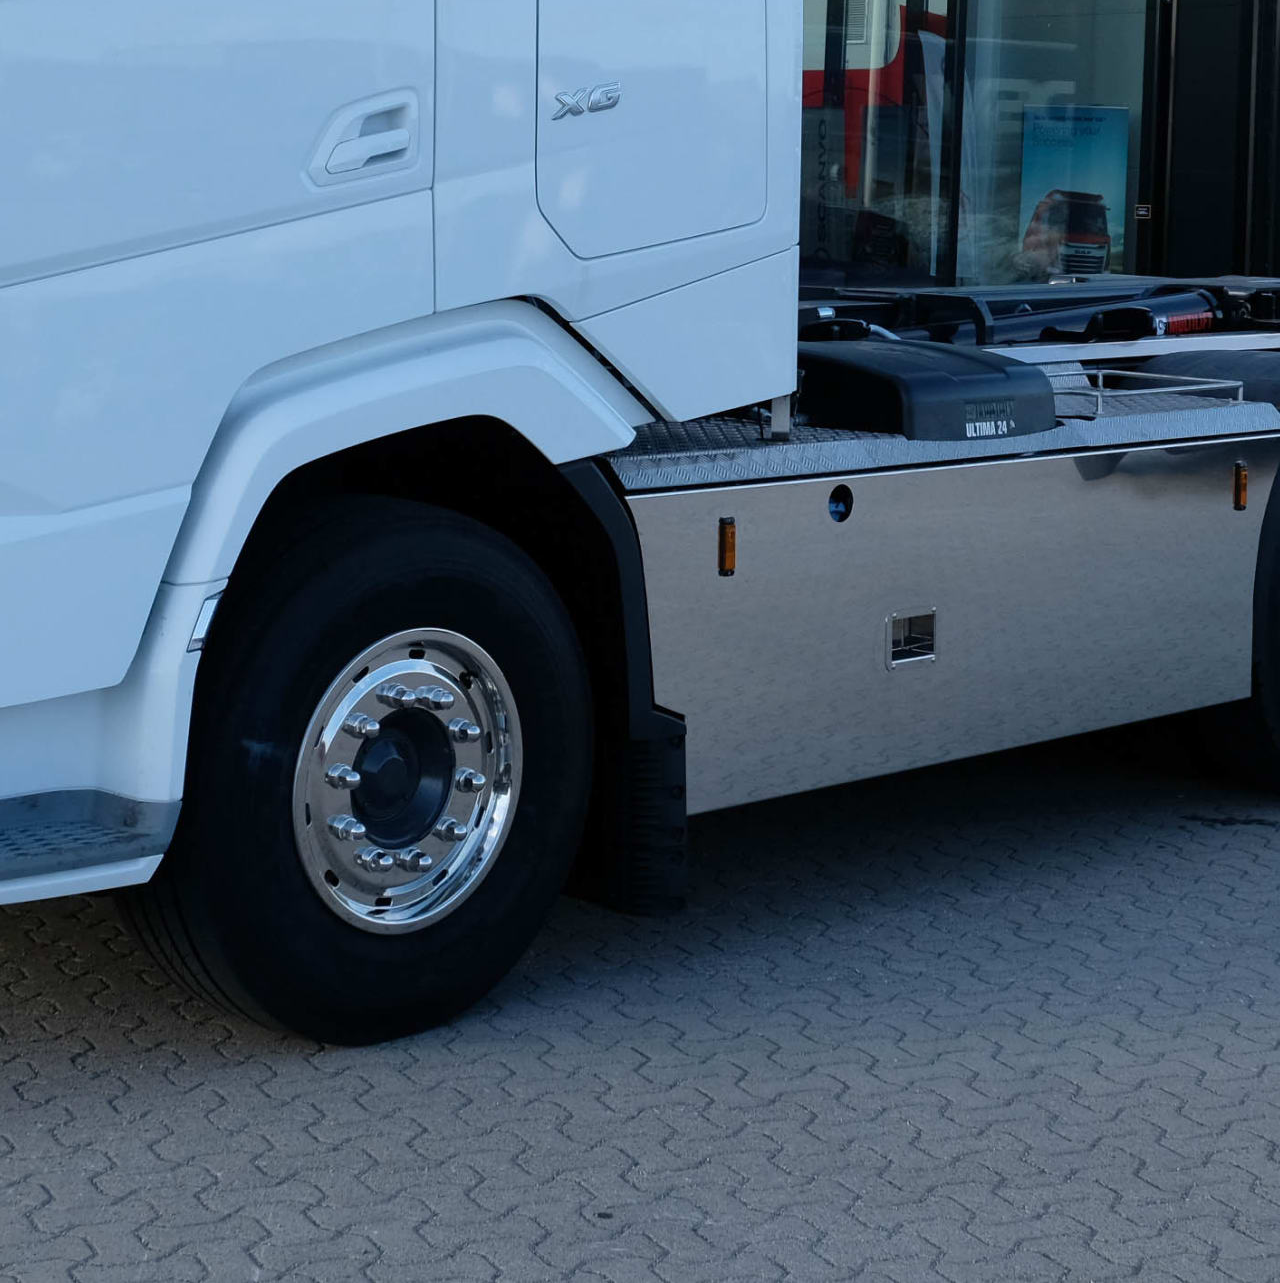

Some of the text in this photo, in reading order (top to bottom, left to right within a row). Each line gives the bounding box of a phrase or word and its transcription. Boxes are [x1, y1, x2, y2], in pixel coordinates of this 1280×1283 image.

[551, 82, 621, 120] XG
[965, 420, 1008, 438] ULTIMA 24
